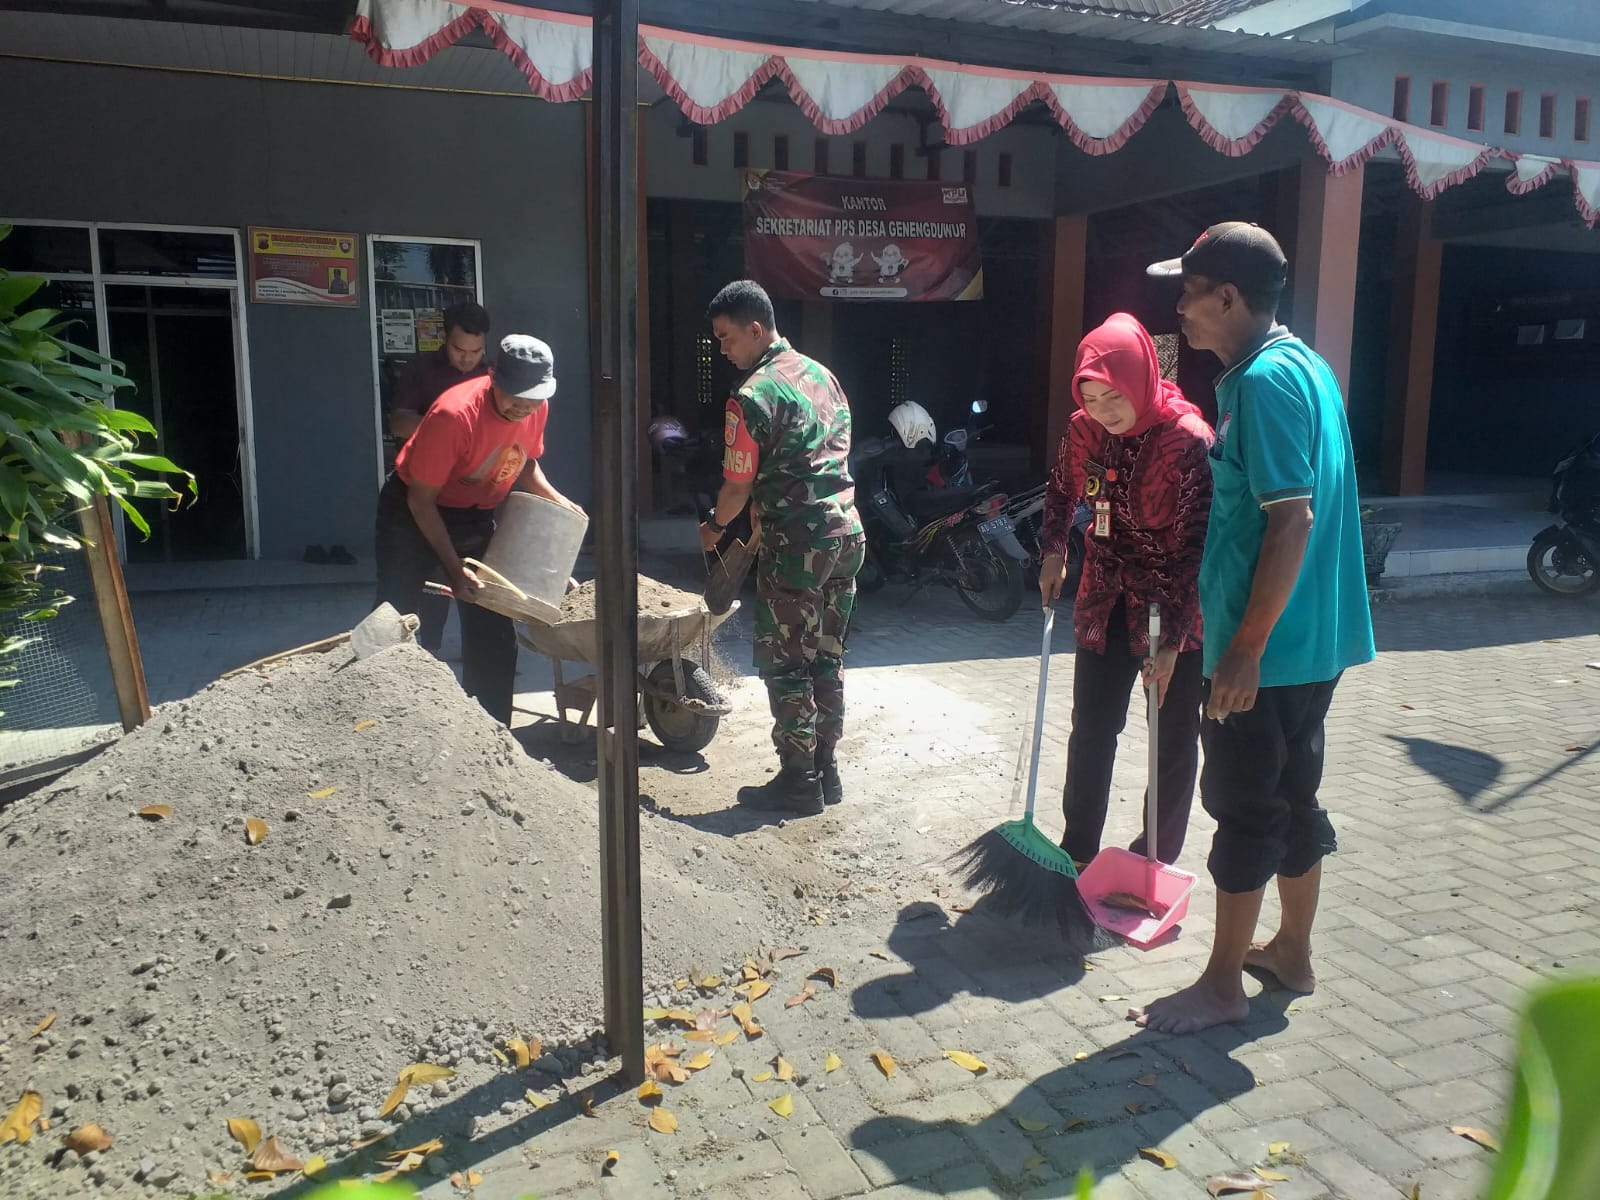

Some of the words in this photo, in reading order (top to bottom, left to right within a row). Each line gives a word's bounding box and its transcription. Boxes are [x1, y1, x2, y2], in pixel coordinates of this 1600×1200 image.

[841, 195, 887, 211] KANTOR
[756, 217, 832, 236] SEKRETARIAT
[835, 219, 855, 237] PPS
[858, 219, 886, 237] DESA
[888, 221, 966, 239] GENENGDUWUR
